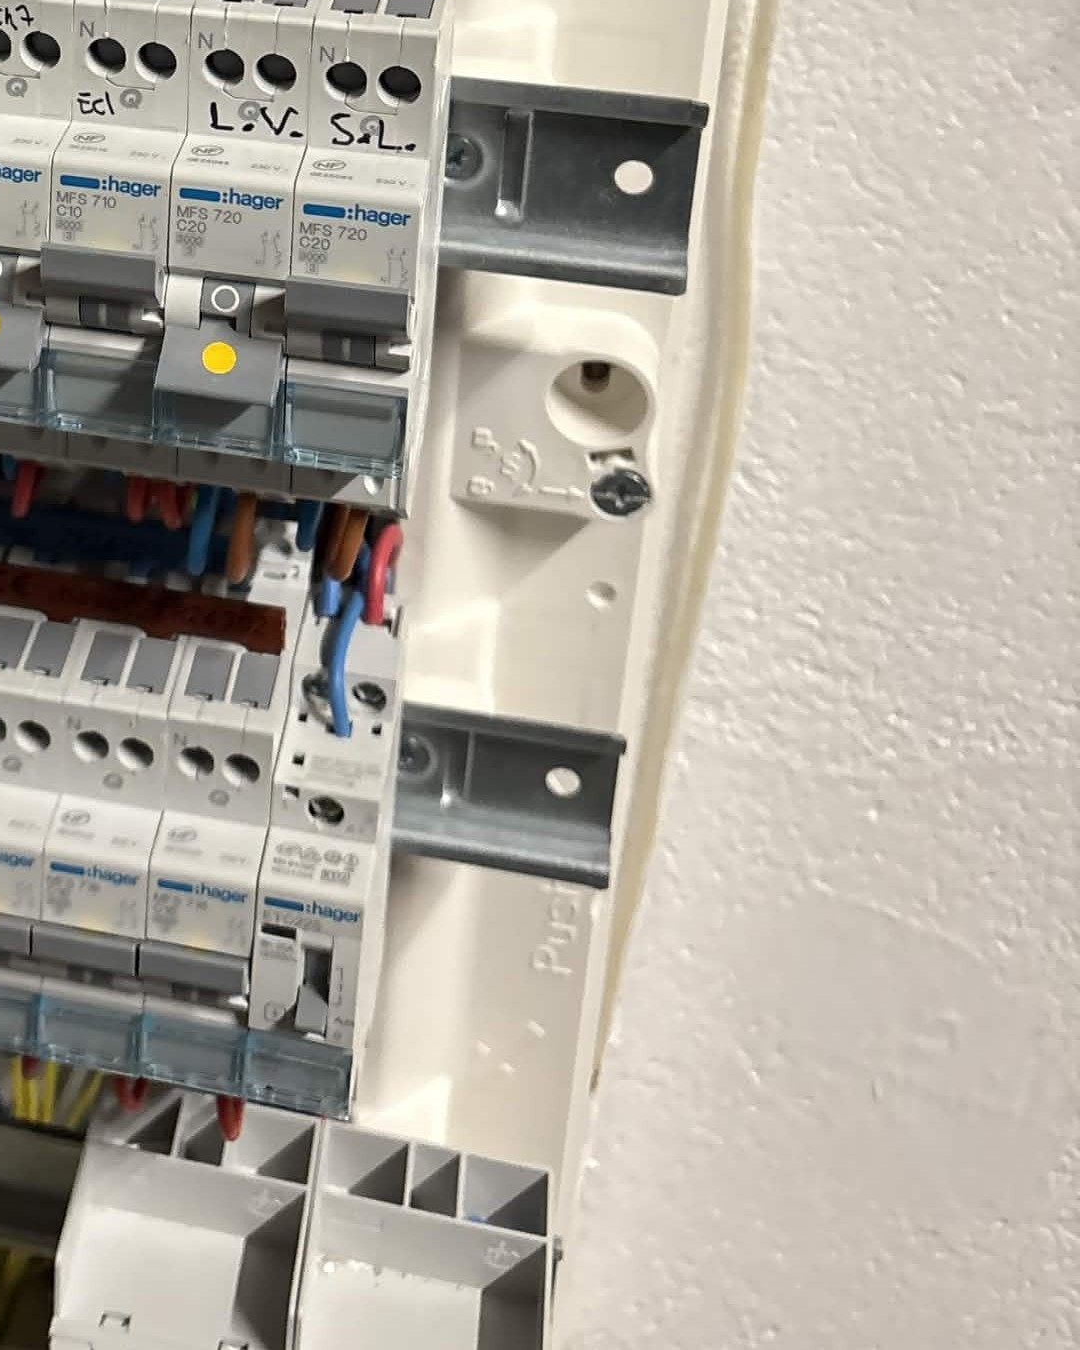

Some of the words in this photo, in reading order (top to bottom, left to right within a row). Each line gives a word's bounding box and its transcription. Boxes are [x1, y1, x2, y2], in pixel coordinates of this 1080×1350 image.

[56, 191, 88, 206] MFS
[92, 194, 117, 209] 710
[176, 205, 209, 220] MFS
[213, 210, 243, 225] 720
[176, 220, 207, 234] C20
[299, 222, 333, 237] MFS
[337, 227, 368, 241] 720
[299, 236, 331, 250] C20
